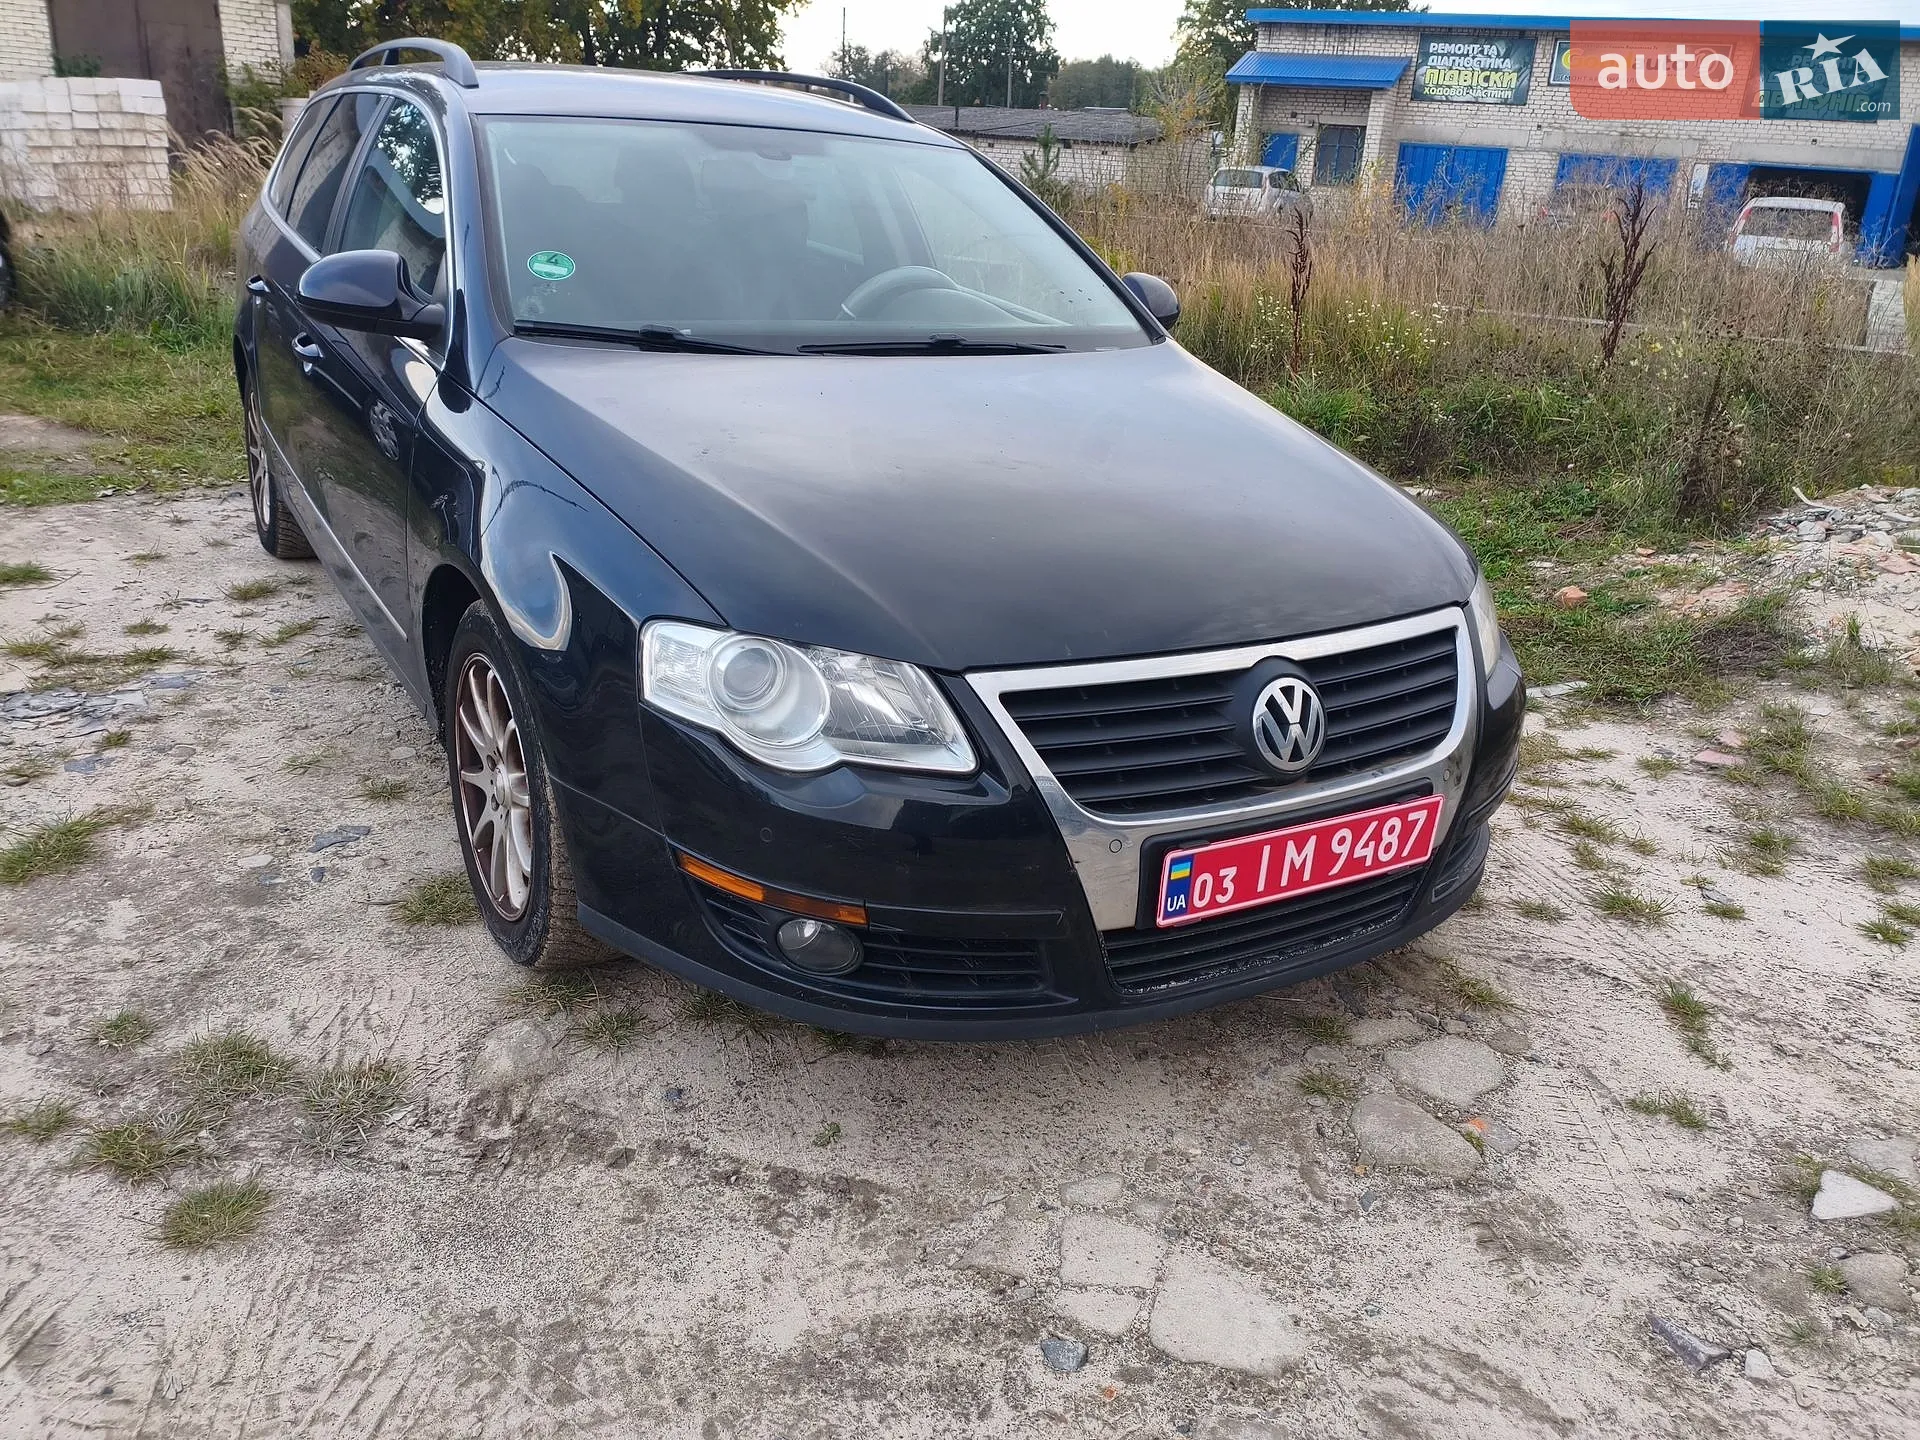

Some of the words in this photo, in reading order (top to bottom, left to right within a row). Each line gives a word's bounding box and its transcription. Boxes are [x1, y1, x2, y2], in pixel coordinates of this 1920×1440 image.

[1429, 42, 1480, 55] РЕМОНТ
[1482, 44, 1498, 56] ТА
[1427, 55, 1512, 69] ДІАГНОСТИКА
[1424, 68, 1518, 89] ПІДВІСКИ
[1423, 86, 1467, 97] ХОДОВОЇ
[1469, 87, 1512, 99] ЧАСТИНИ
[1192, 866, 1238, 908] 03
[1257, 835, 1317, 892] IM
[1328, 809, 1428, 876] 9487
[1167, 893, 1187, 912] UA
